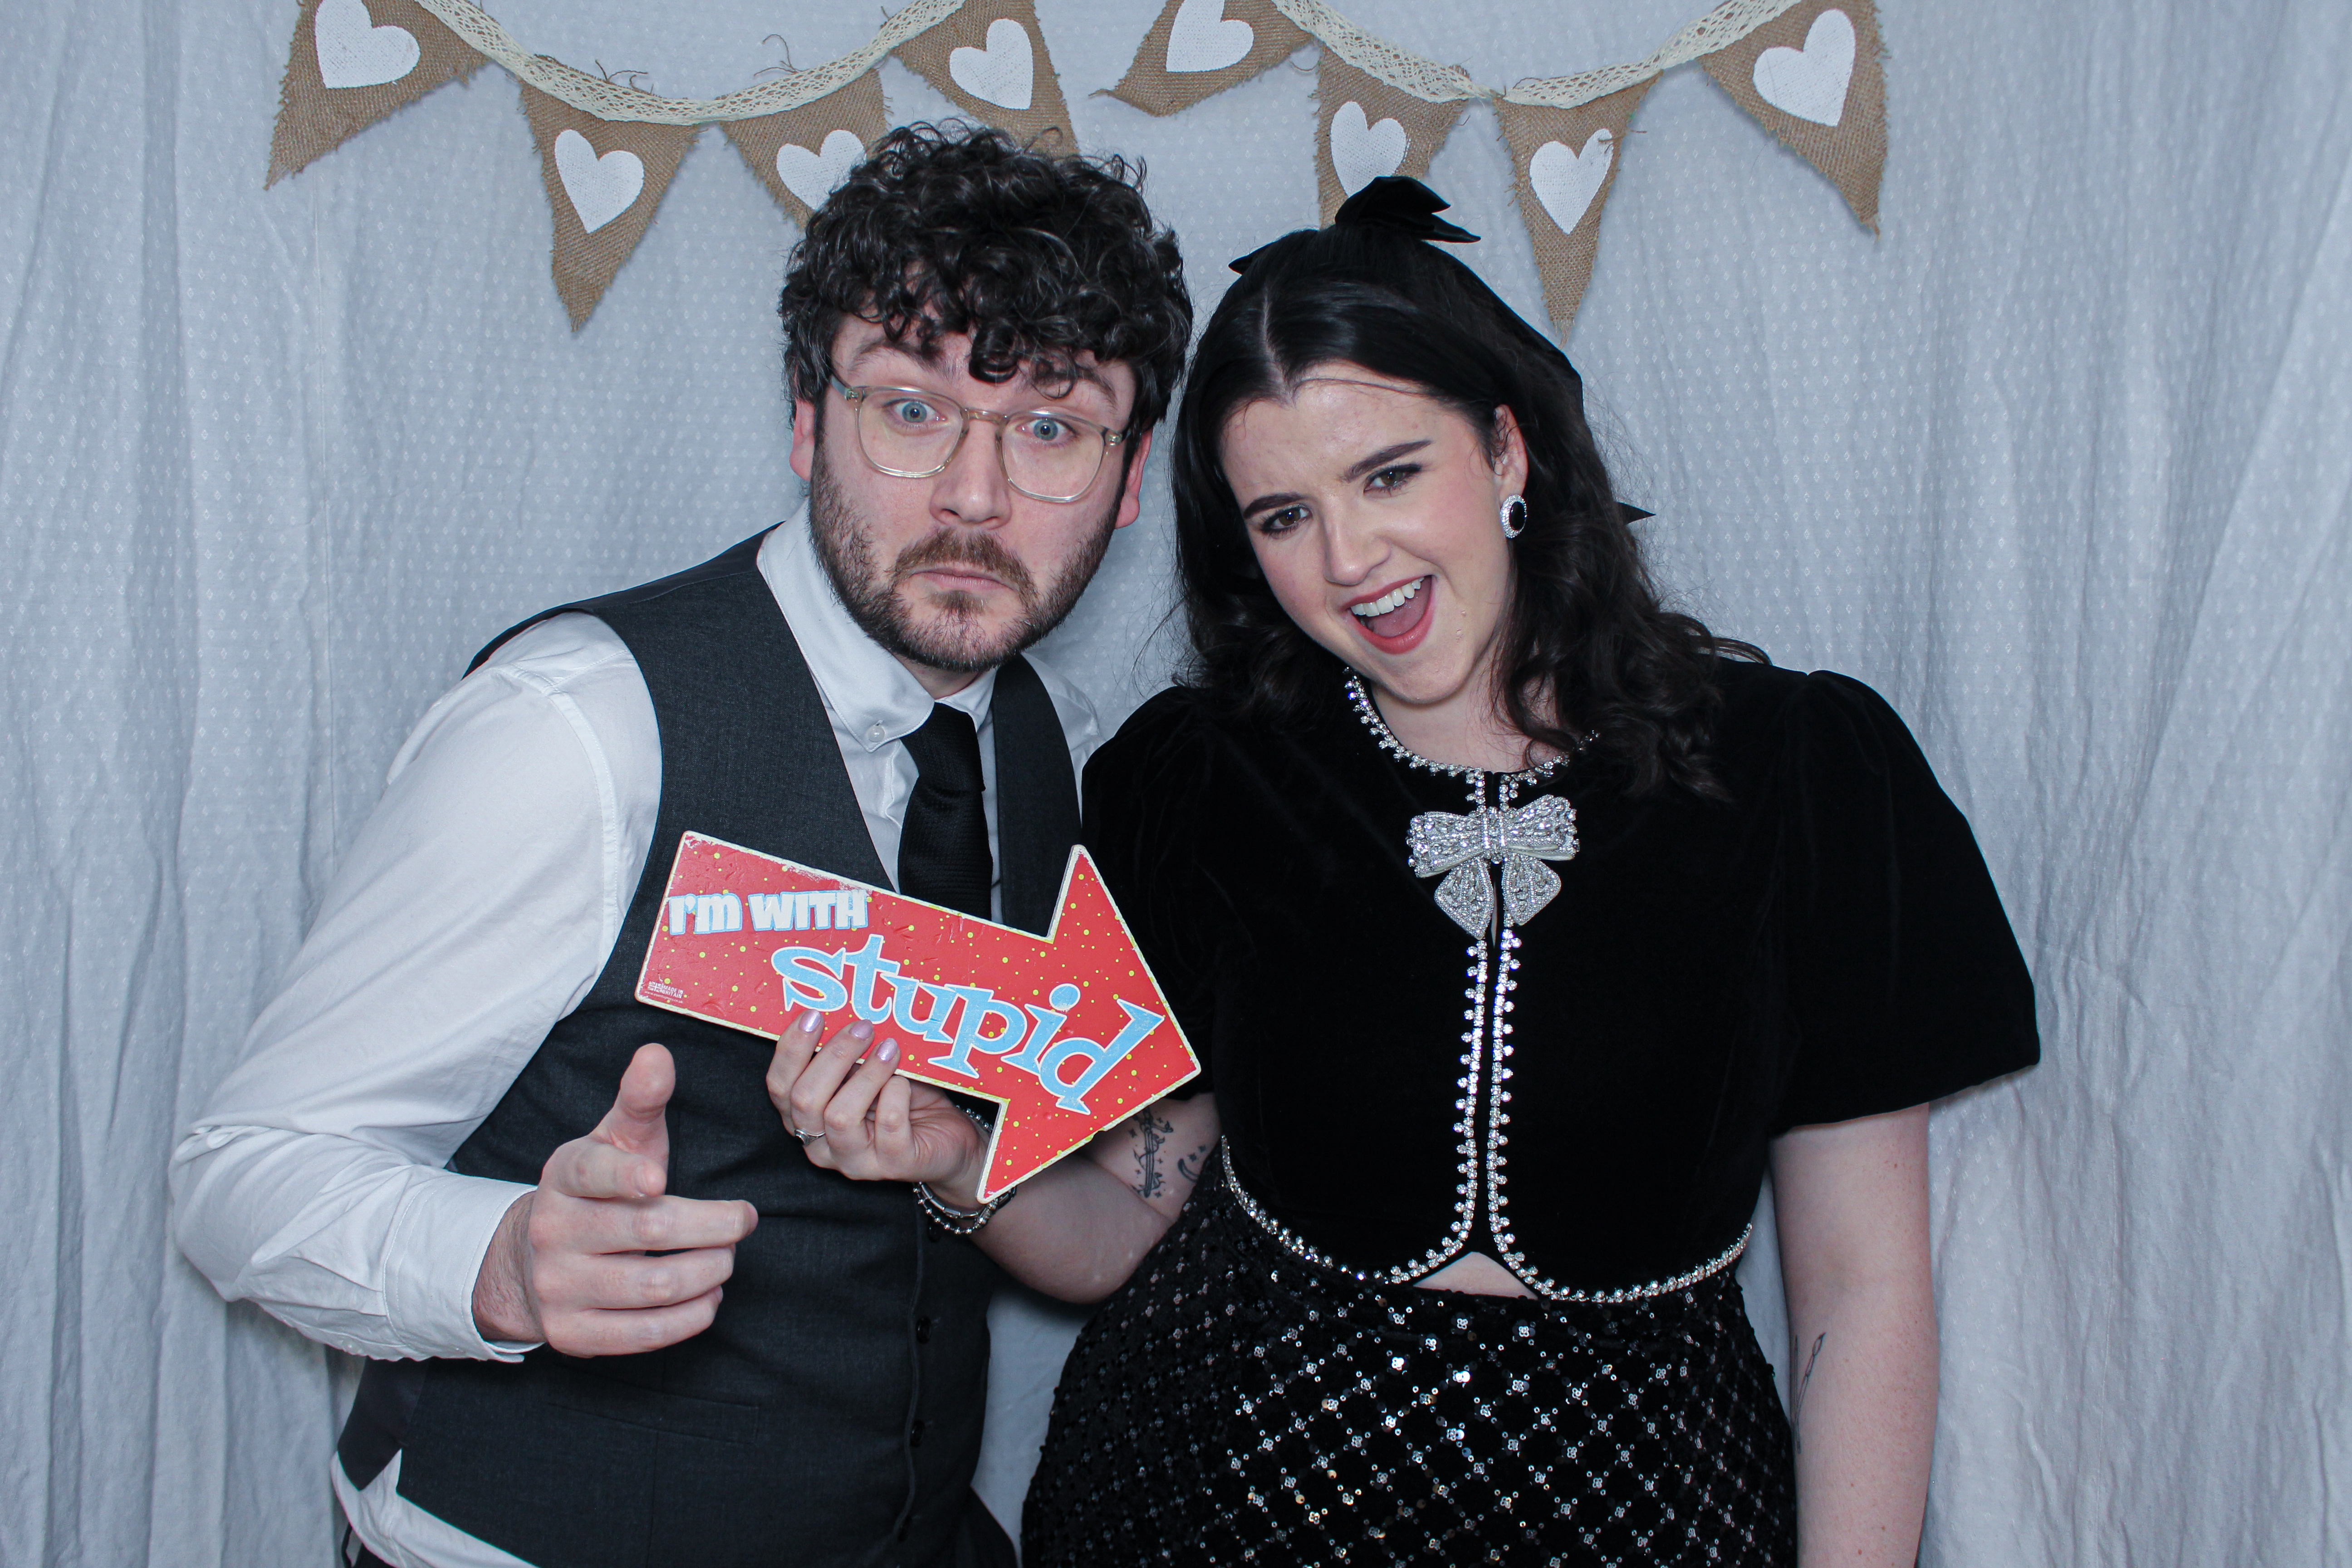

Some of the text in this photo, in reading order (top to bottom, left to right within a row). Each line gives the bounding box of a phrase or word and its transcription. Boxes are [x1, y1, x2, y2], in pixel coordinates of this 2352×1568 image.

[748, 890, 868, 931] WITH
[662, 990, 682, 999] BRITAIN
[770, 934, 1164, 1115] stupid
